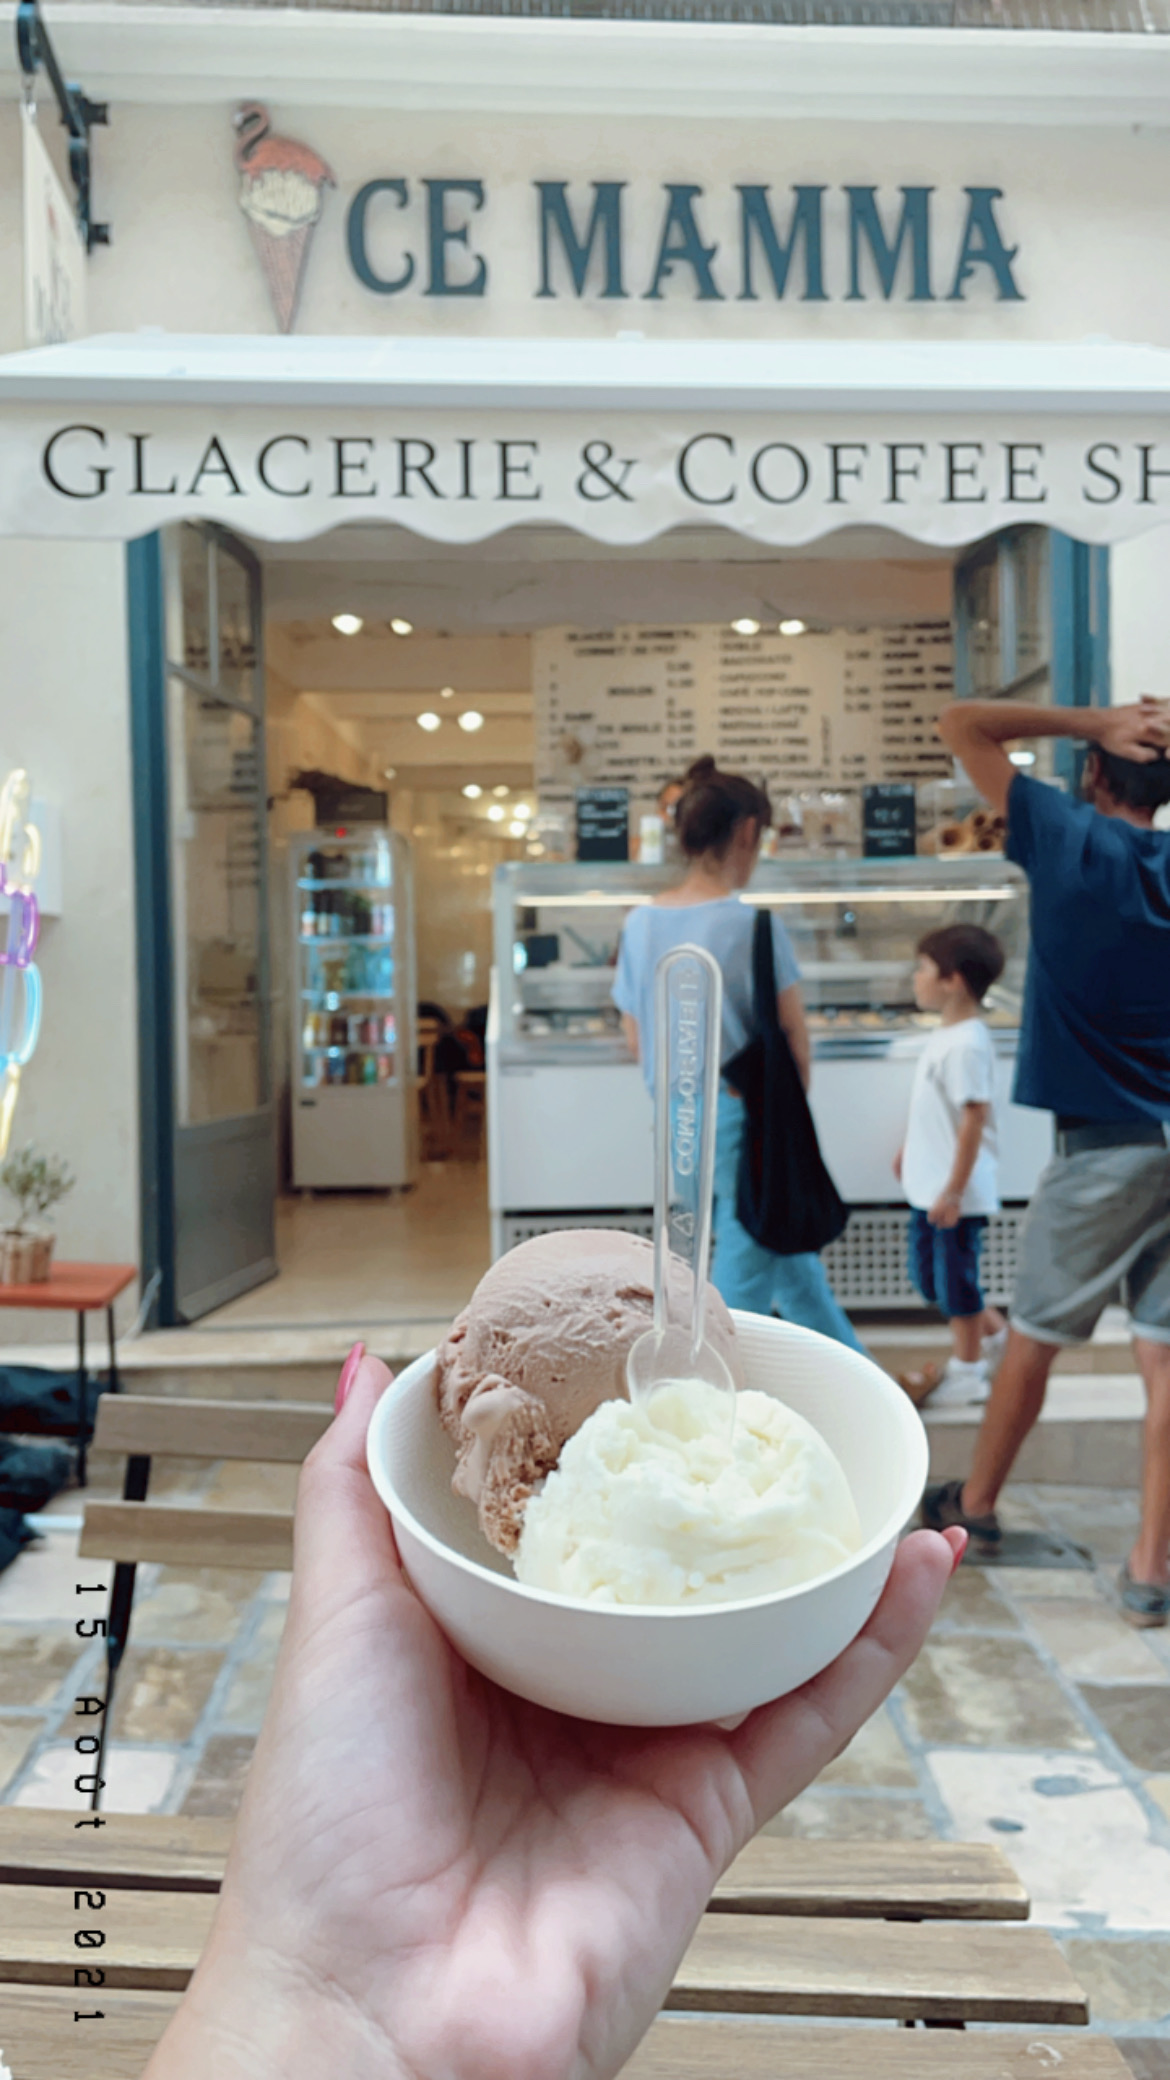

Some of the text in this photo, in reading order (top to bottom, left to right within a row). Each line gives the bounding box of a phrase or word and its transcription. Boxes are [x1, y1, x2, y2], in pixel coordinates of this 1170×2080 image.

[532, 180, 1027, 302] MAMMA
[41, 424, 542, 501] GLACERIE
[576, 439, 637, 502] &
[676, 432, 1047, 505] COFFEE
